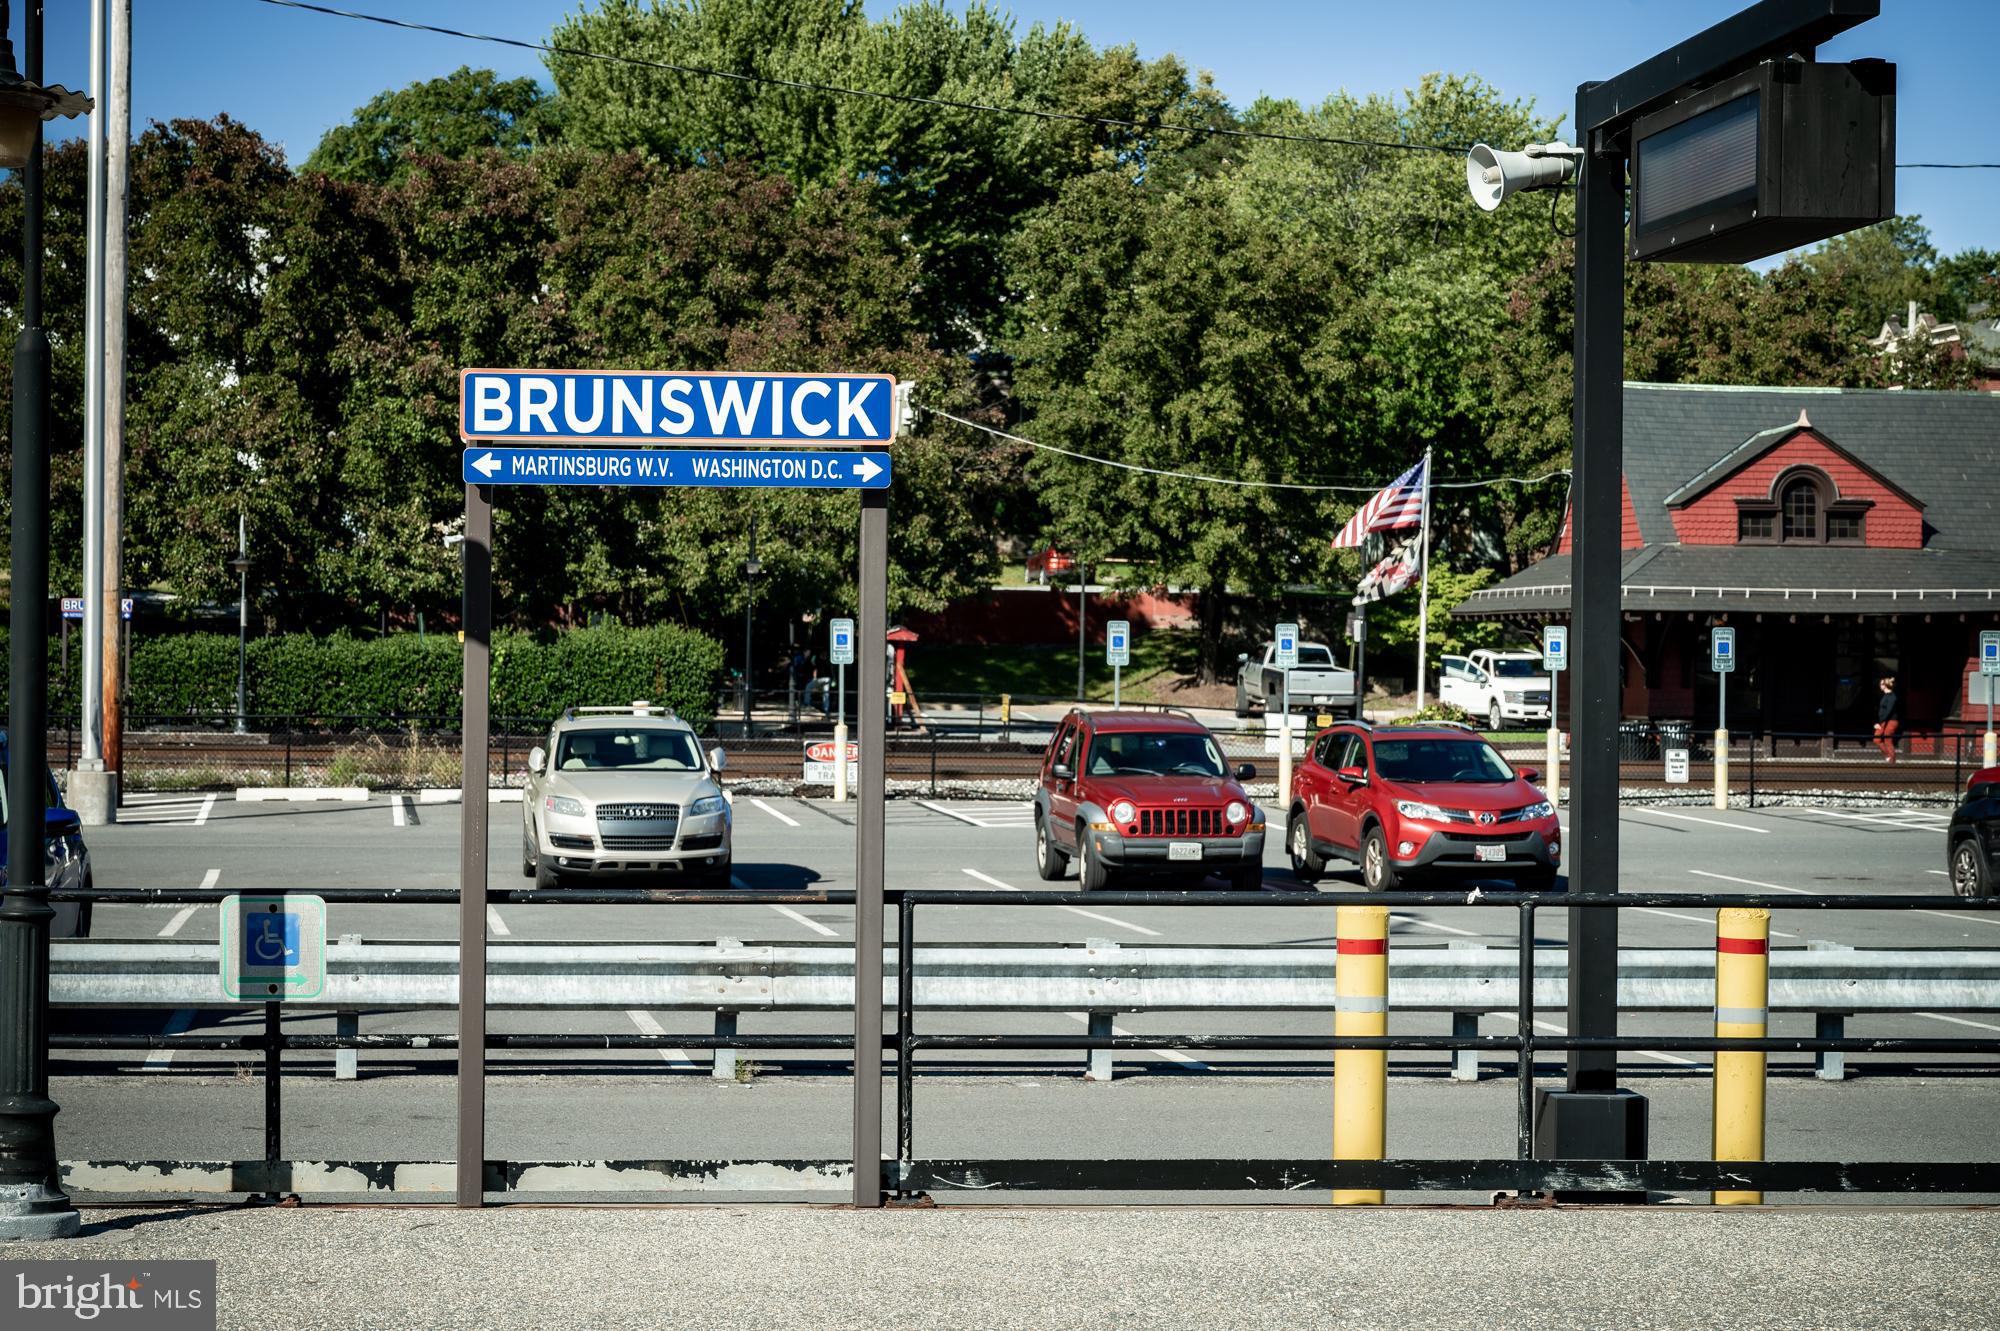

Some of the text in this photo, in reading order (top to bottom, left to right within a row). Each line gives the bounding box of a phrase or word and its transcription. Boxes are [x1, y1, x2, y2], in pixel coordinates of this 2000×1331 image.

[473, 376, 879, 437] BRUNSWICK
[512, 456, 674, 478] MARTINSBURG W.V.
[692, 458, 843, 480] WASHINGTON D.C.
[812, 746, 858, 758] DANER
